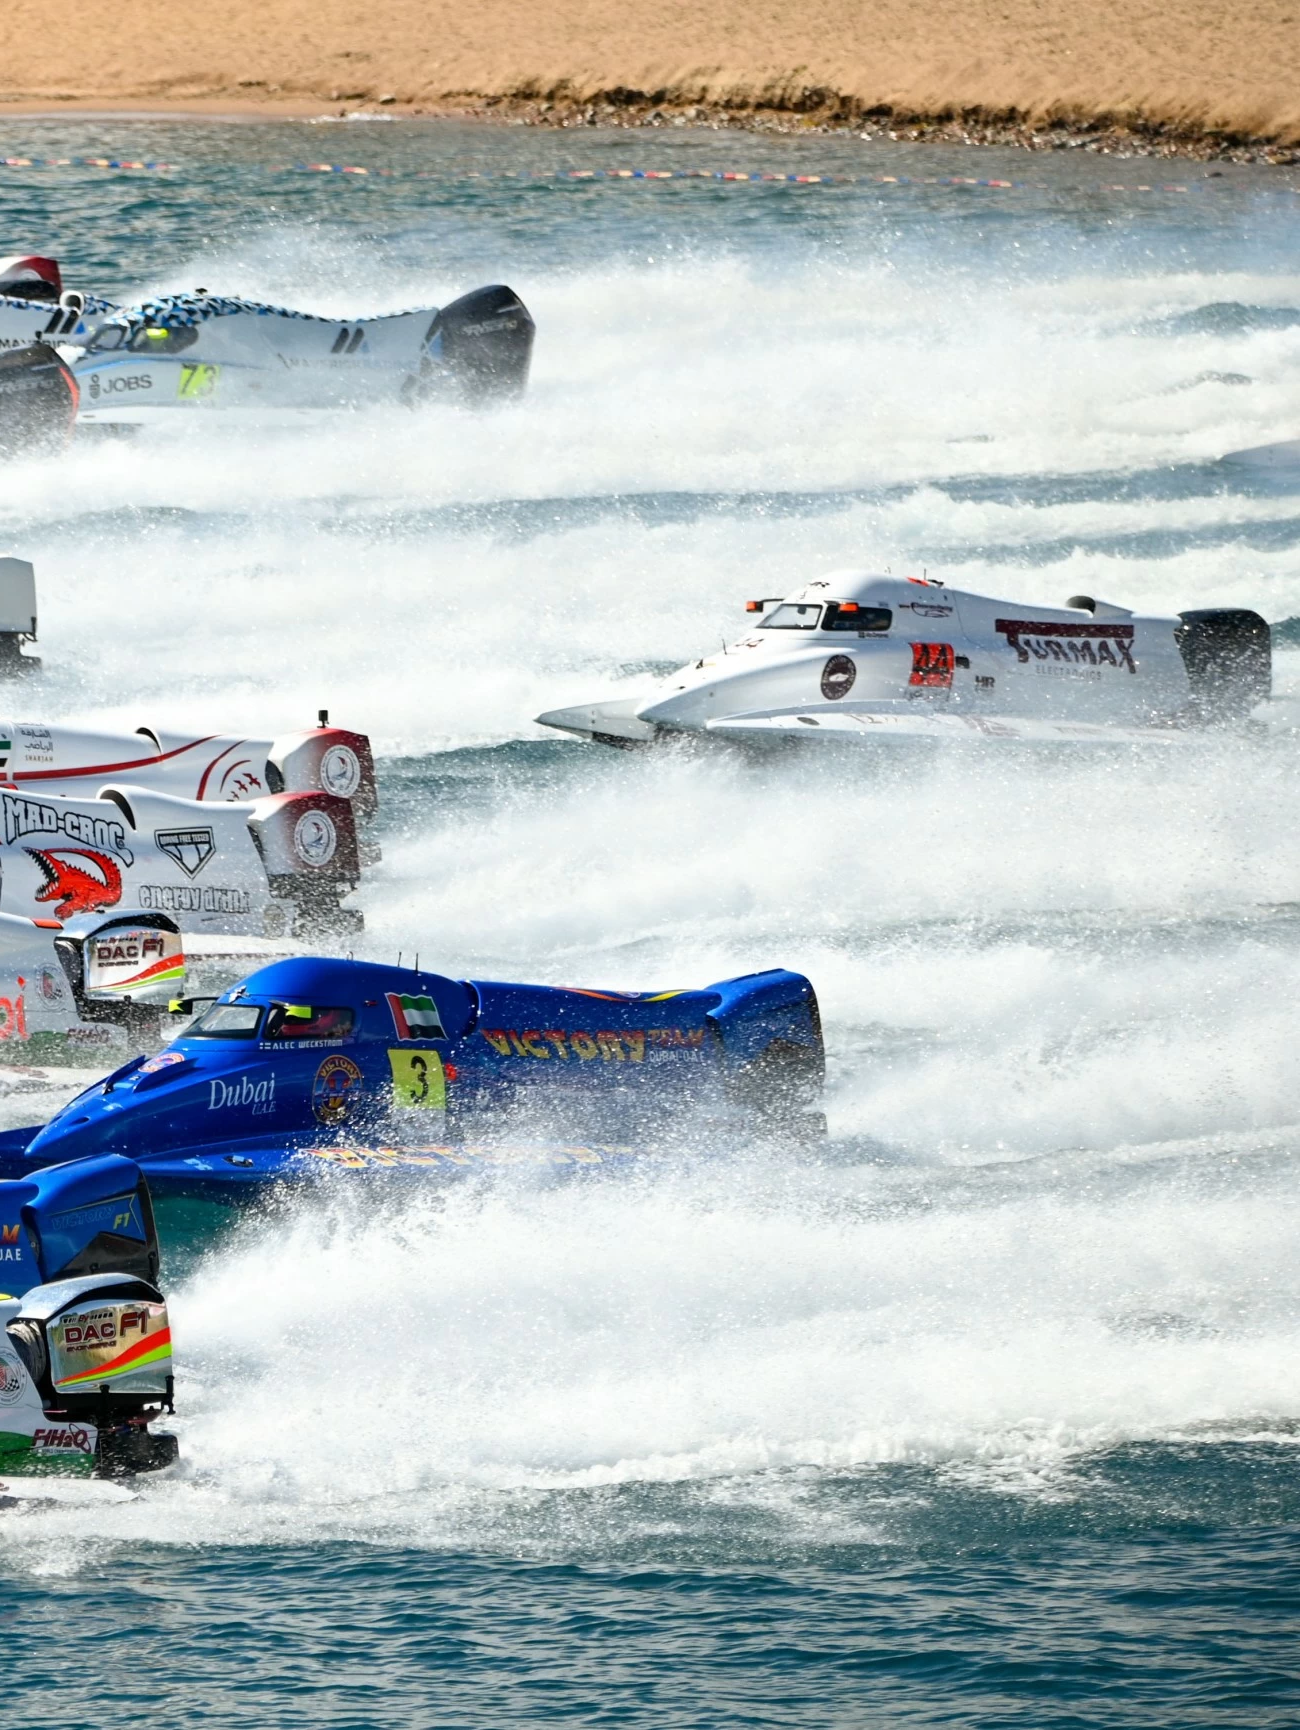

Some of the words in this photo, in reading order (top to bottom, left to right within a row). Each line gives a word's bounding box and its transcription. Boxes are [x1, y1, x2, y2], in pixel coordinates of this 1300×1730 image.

[102, 374, 153, 394] JOBS
[181, 362, 217, 396] 73
[995, 619, 1137, 674] TURMAX
[2, 794, 134, 868] MAD-CROC
[138, 884, 201, 912] energy
[97, 946, 139, 960] DAC
[272, 1042, 295, 1050] ALEC
[481, 1029, 646, 1062] VICTORY
[647, 1026, 705, 1047] TEAM
[648, 1048, 679, 1063] DUBAI
[320, 1058, 358, 1079] VICTORY
[410, 1055, 429, 1104] 3
[208, 1073, 277, 1111] Dubai
[112, 1214, 130, 1229] F1
[64, 1322, 116, 1344] DAC
[119, 1311, 147, 1337] F1
